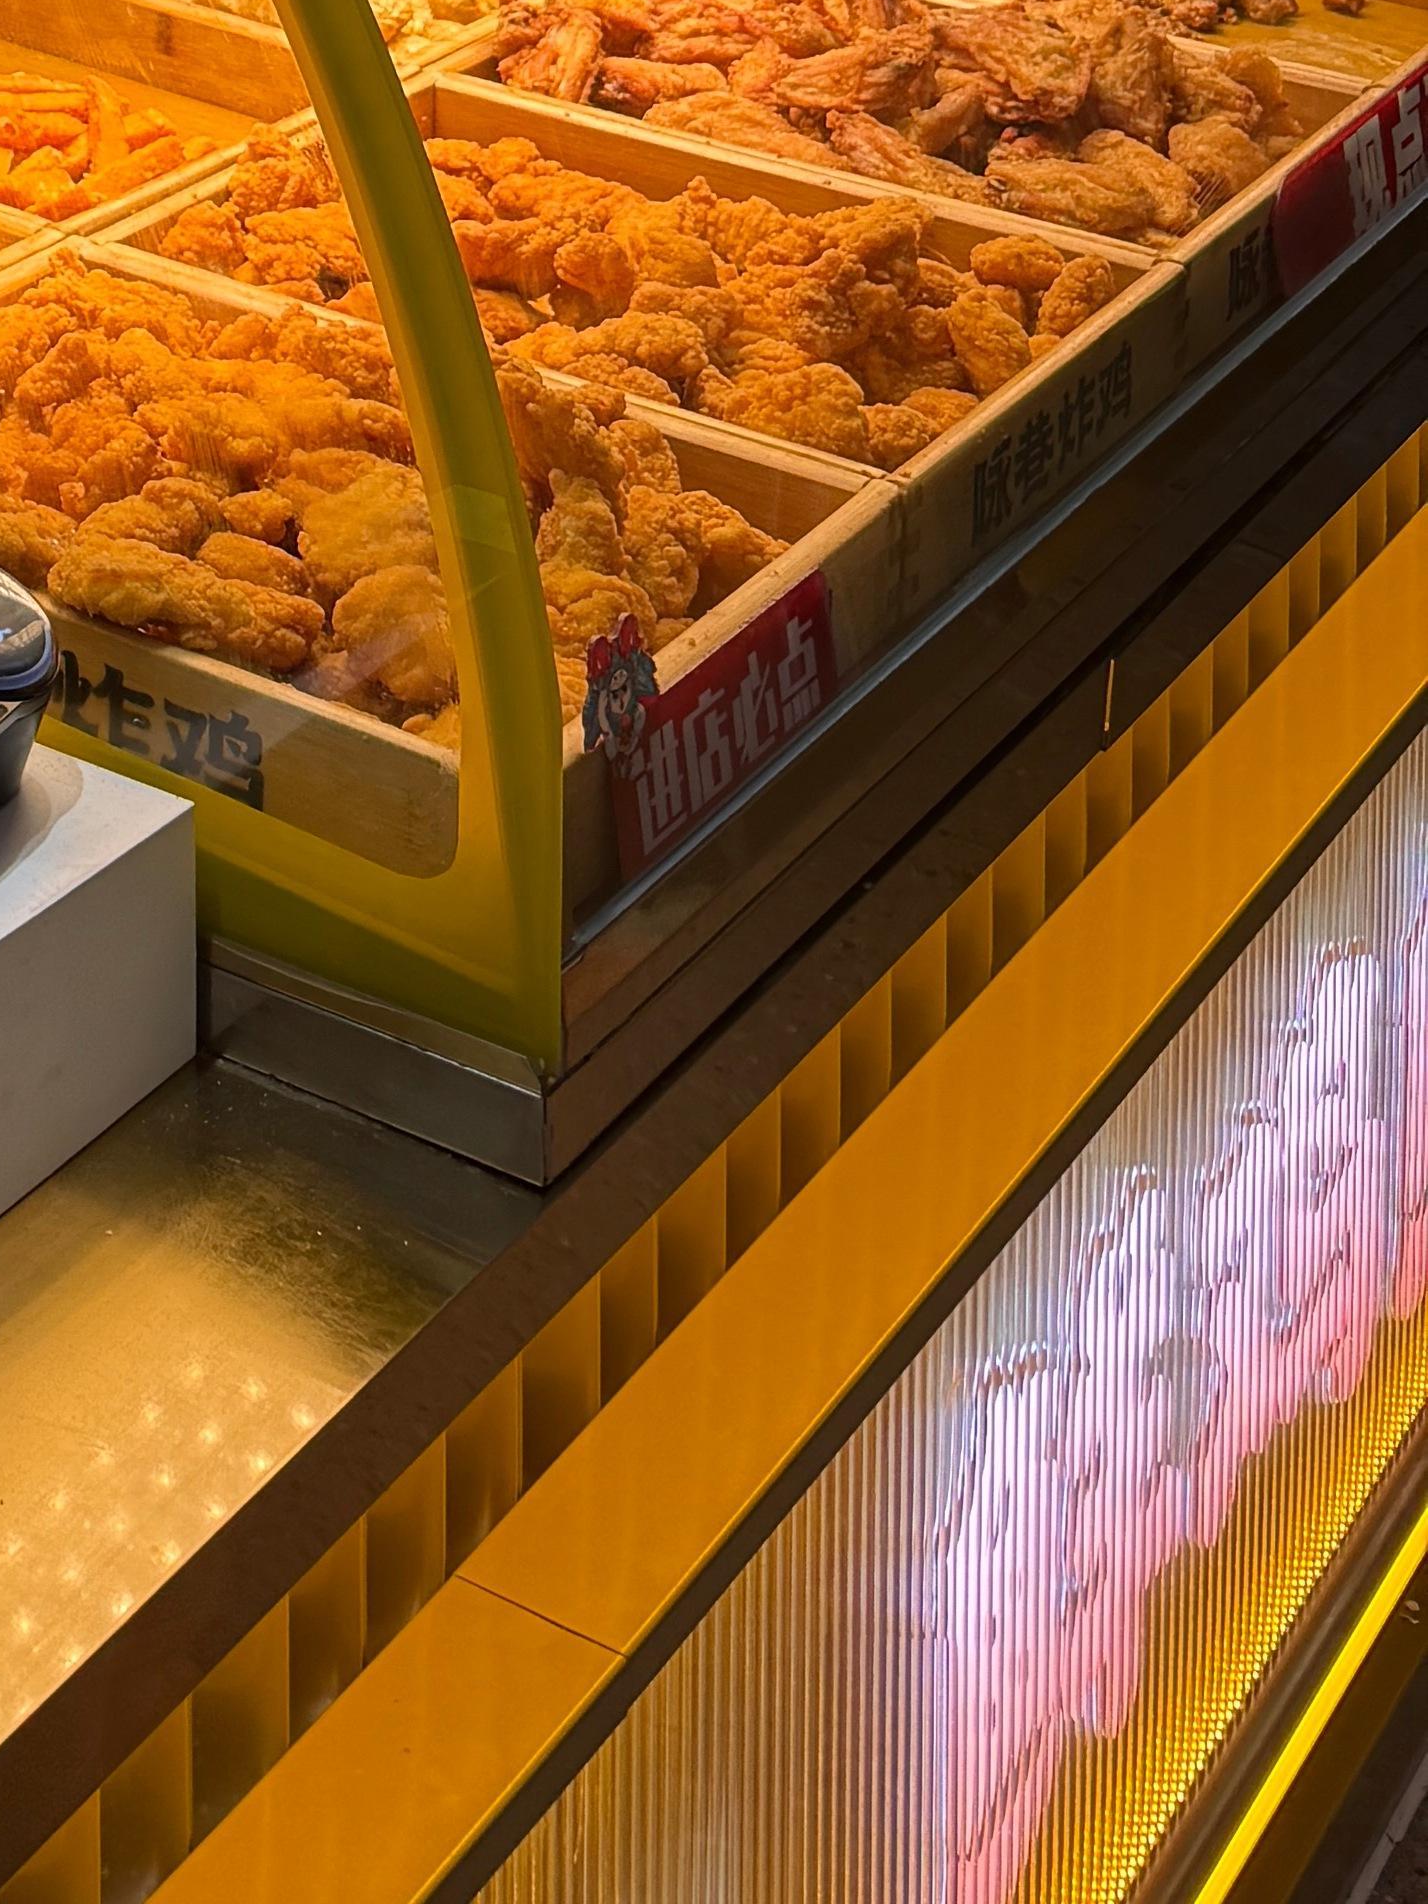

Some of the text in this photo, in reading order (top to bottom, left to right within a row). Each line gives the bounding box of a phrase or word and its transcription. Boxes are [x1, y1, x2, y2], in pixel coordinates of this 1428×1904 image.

[971, 338, 1134, 548] 咏巷炸鸡
[636, 613, 819, 855] 进店必点
